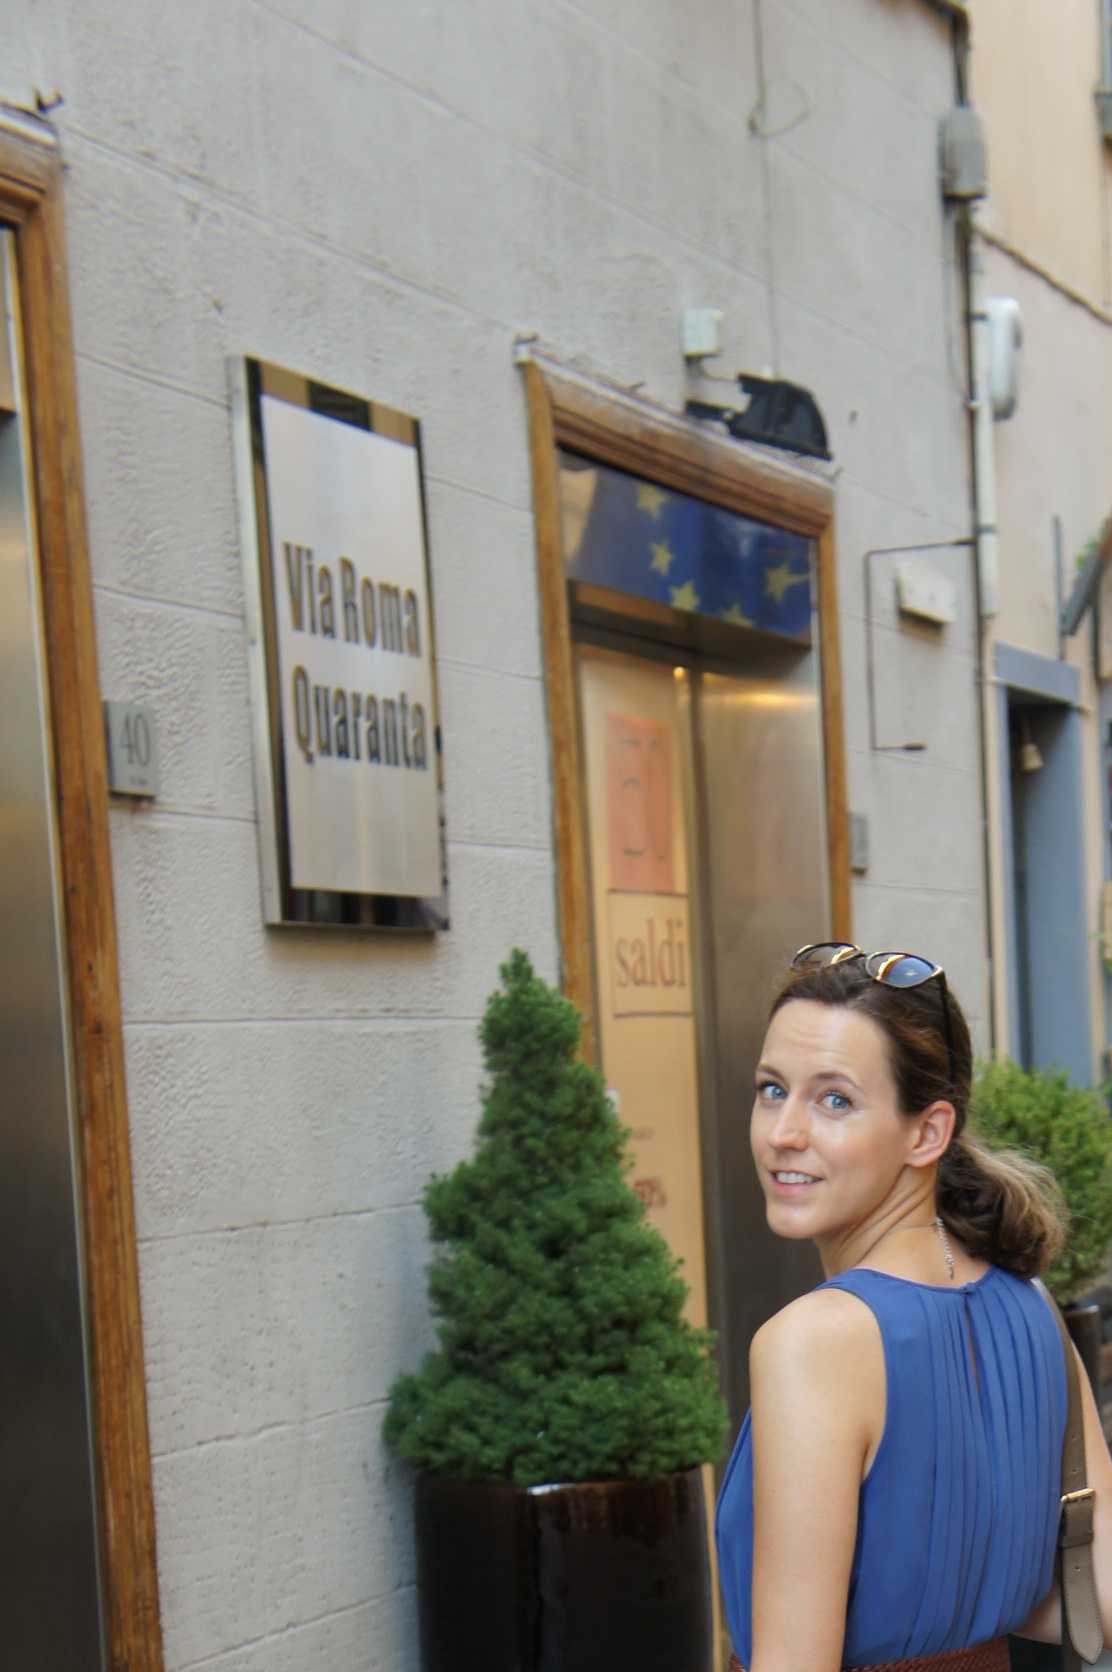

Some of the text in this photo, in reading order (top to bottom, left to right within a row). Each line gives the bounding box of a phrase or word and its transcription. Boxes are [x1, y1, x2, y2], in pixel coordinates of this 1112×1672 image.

[283, 541, 421, 658] Via Roma
[120, 711, 150, 767] 40
[293, 664, 427, 771] Quaranta
[615, 917, 689, 989] saldi
